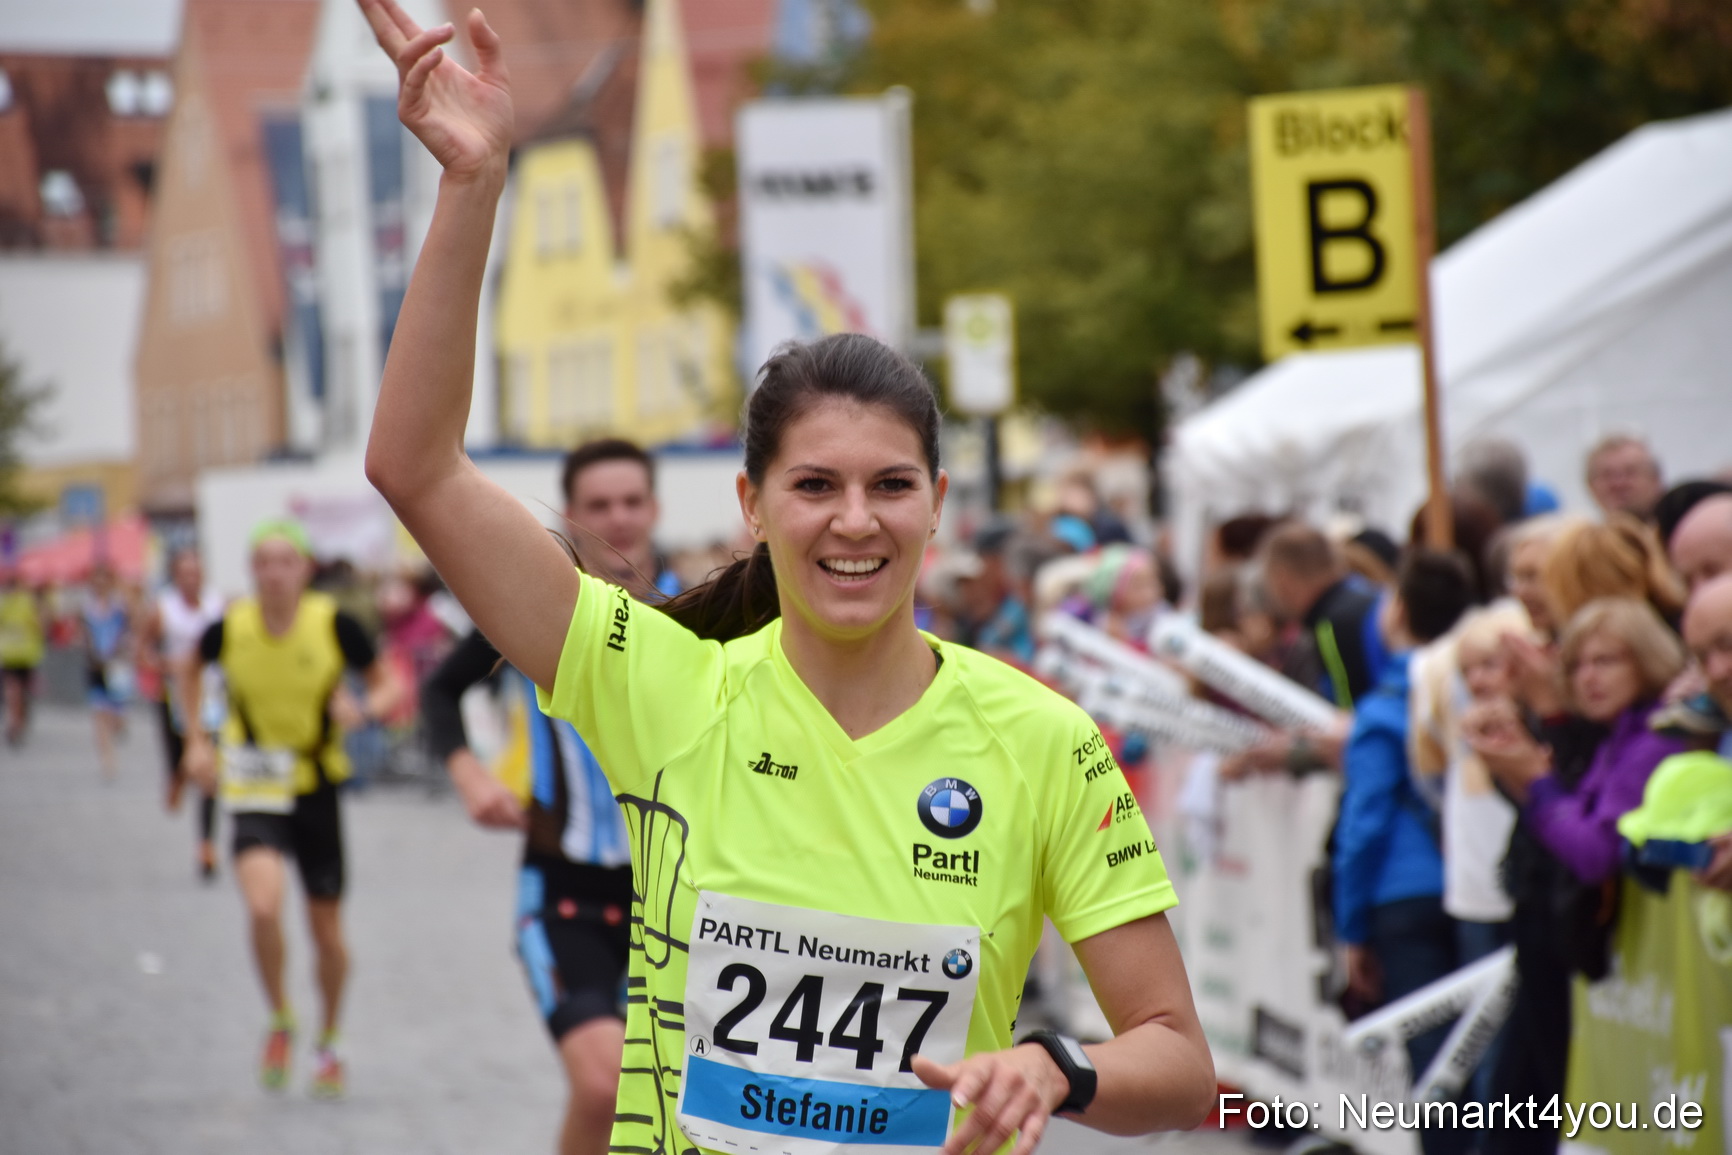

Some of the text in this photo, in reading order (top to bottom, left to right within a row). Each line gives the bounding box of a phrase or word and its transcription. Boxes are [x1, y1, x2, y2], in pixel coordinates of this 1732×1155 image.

[1306, 178, 1387, 295] B
[924, 779, 978, 801] BMW
[912, 843, 980, 875] Partl
[1106, 841, 1142, 868] BMW
[913, 866, 978, 888] Neumarkt
[698, 917, 931, 974] PARTL Neumarkt
[712, 962, 950, 1074] 2447
[695, 1038, 705, 1055] A
[739, 1083, 890, 1135] Stefanie
